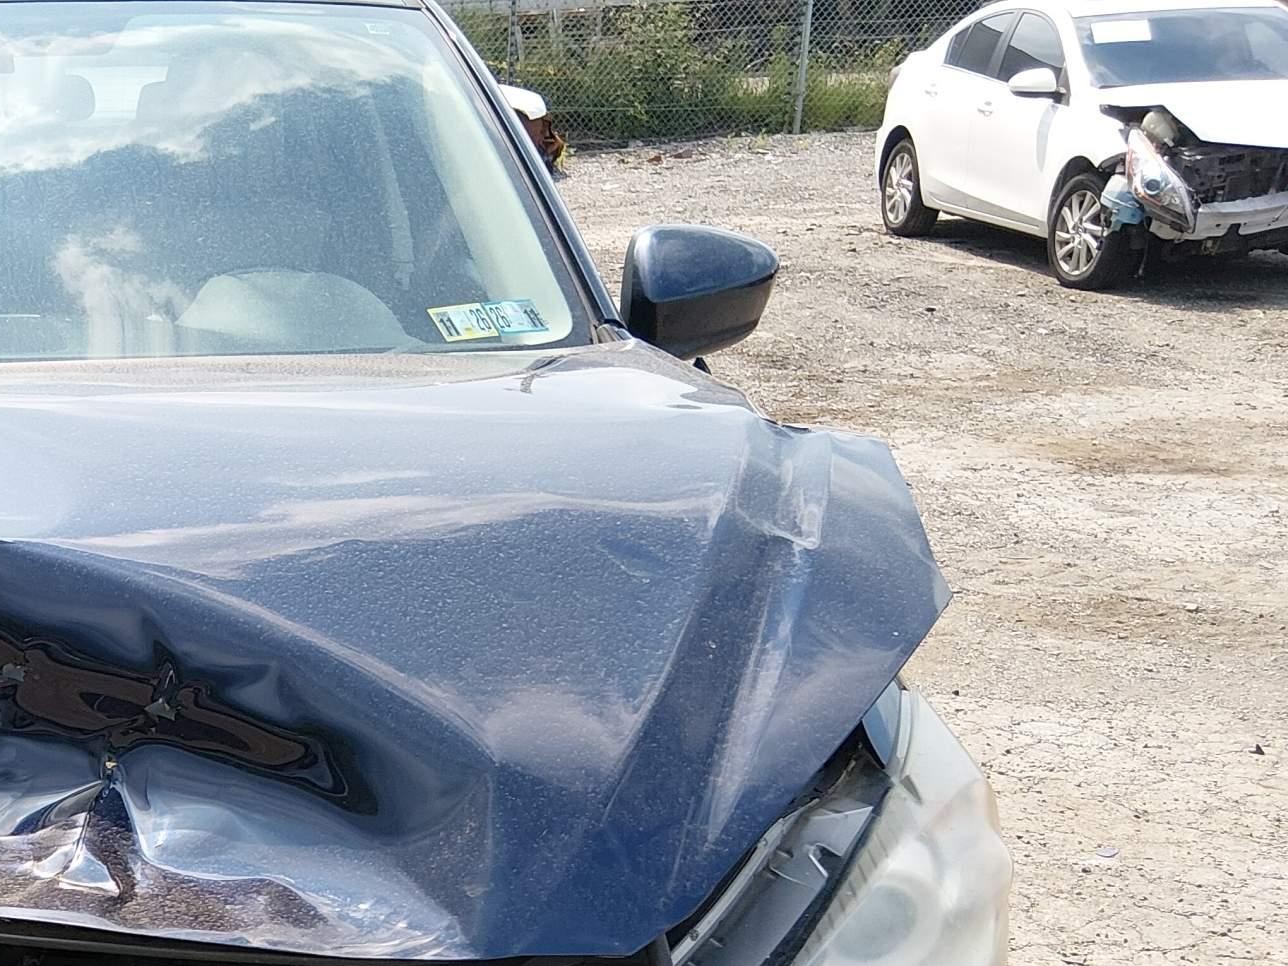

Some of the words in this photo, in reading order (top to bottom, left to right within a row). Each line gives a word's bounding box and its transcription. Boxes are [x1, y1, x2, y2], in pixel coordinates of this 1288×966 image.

[439, 316, 461, 336] 11
[469, 308, 492, 331] 26
[489, 306, 511, 328] 26
